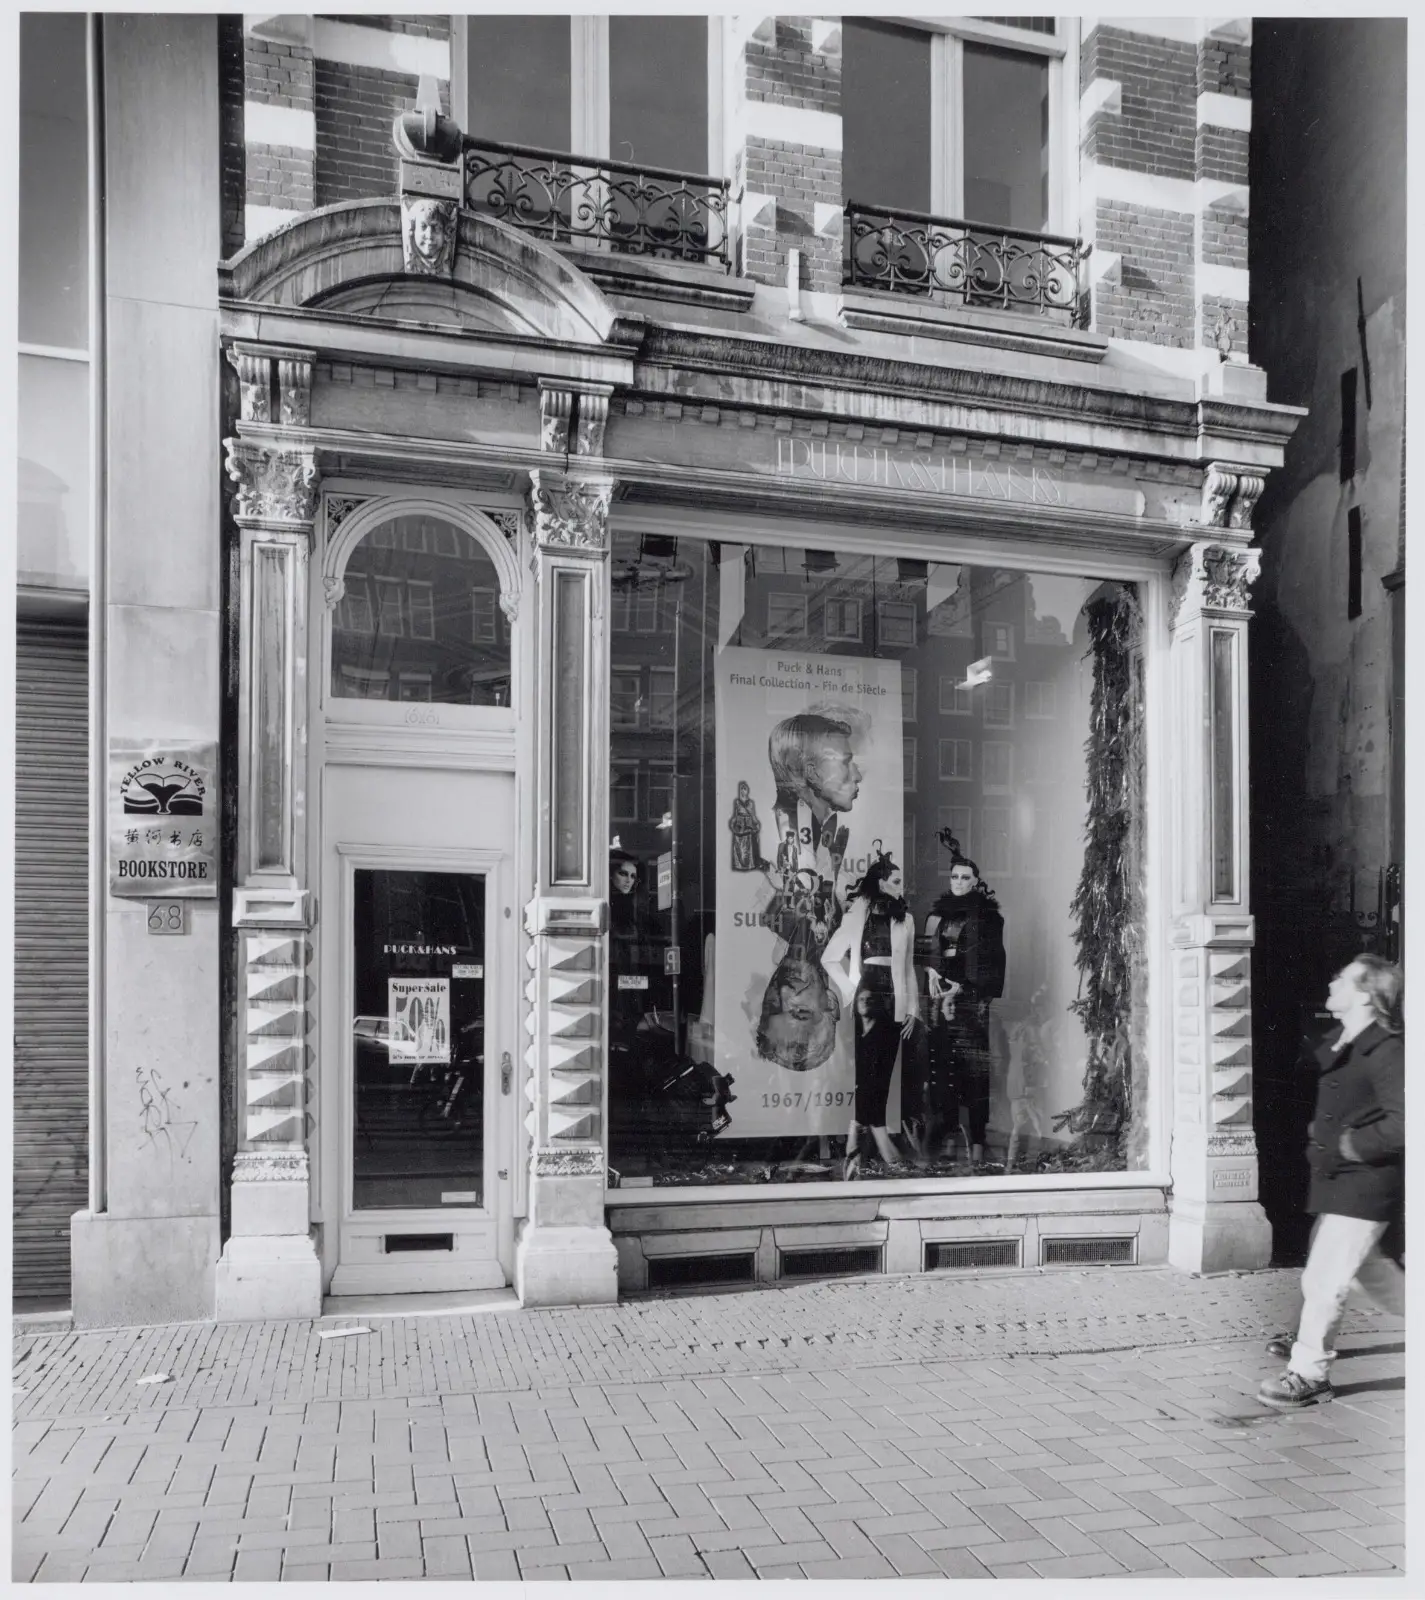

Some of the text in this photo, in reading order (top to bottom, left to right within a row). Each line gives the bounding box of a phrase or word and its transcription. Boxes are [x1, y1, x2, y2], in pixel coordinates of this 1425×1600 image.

[778, 437, 1062, 504] PUCK&HANS
[777, 661, 842, 677] Puck & Hans
[729, 673, 756, 686] Final
[759, 676, 811, 690] Collection
[822, 681, 838, 693] Fin
[841, 682, 854, 694] de
[857, 682, 887, 696] Siècle
[120, 757, 206, 796] YELLOW RIVER
[124, 828, 203, 847] 黄河书店
[118, 859, 208, 879] BOOKSTORE
[148, 905, 182, 930] 68
[383, 944, 457, 956] PUCK&HANS
[761, 1091, 855, 1112] 1967/1997
